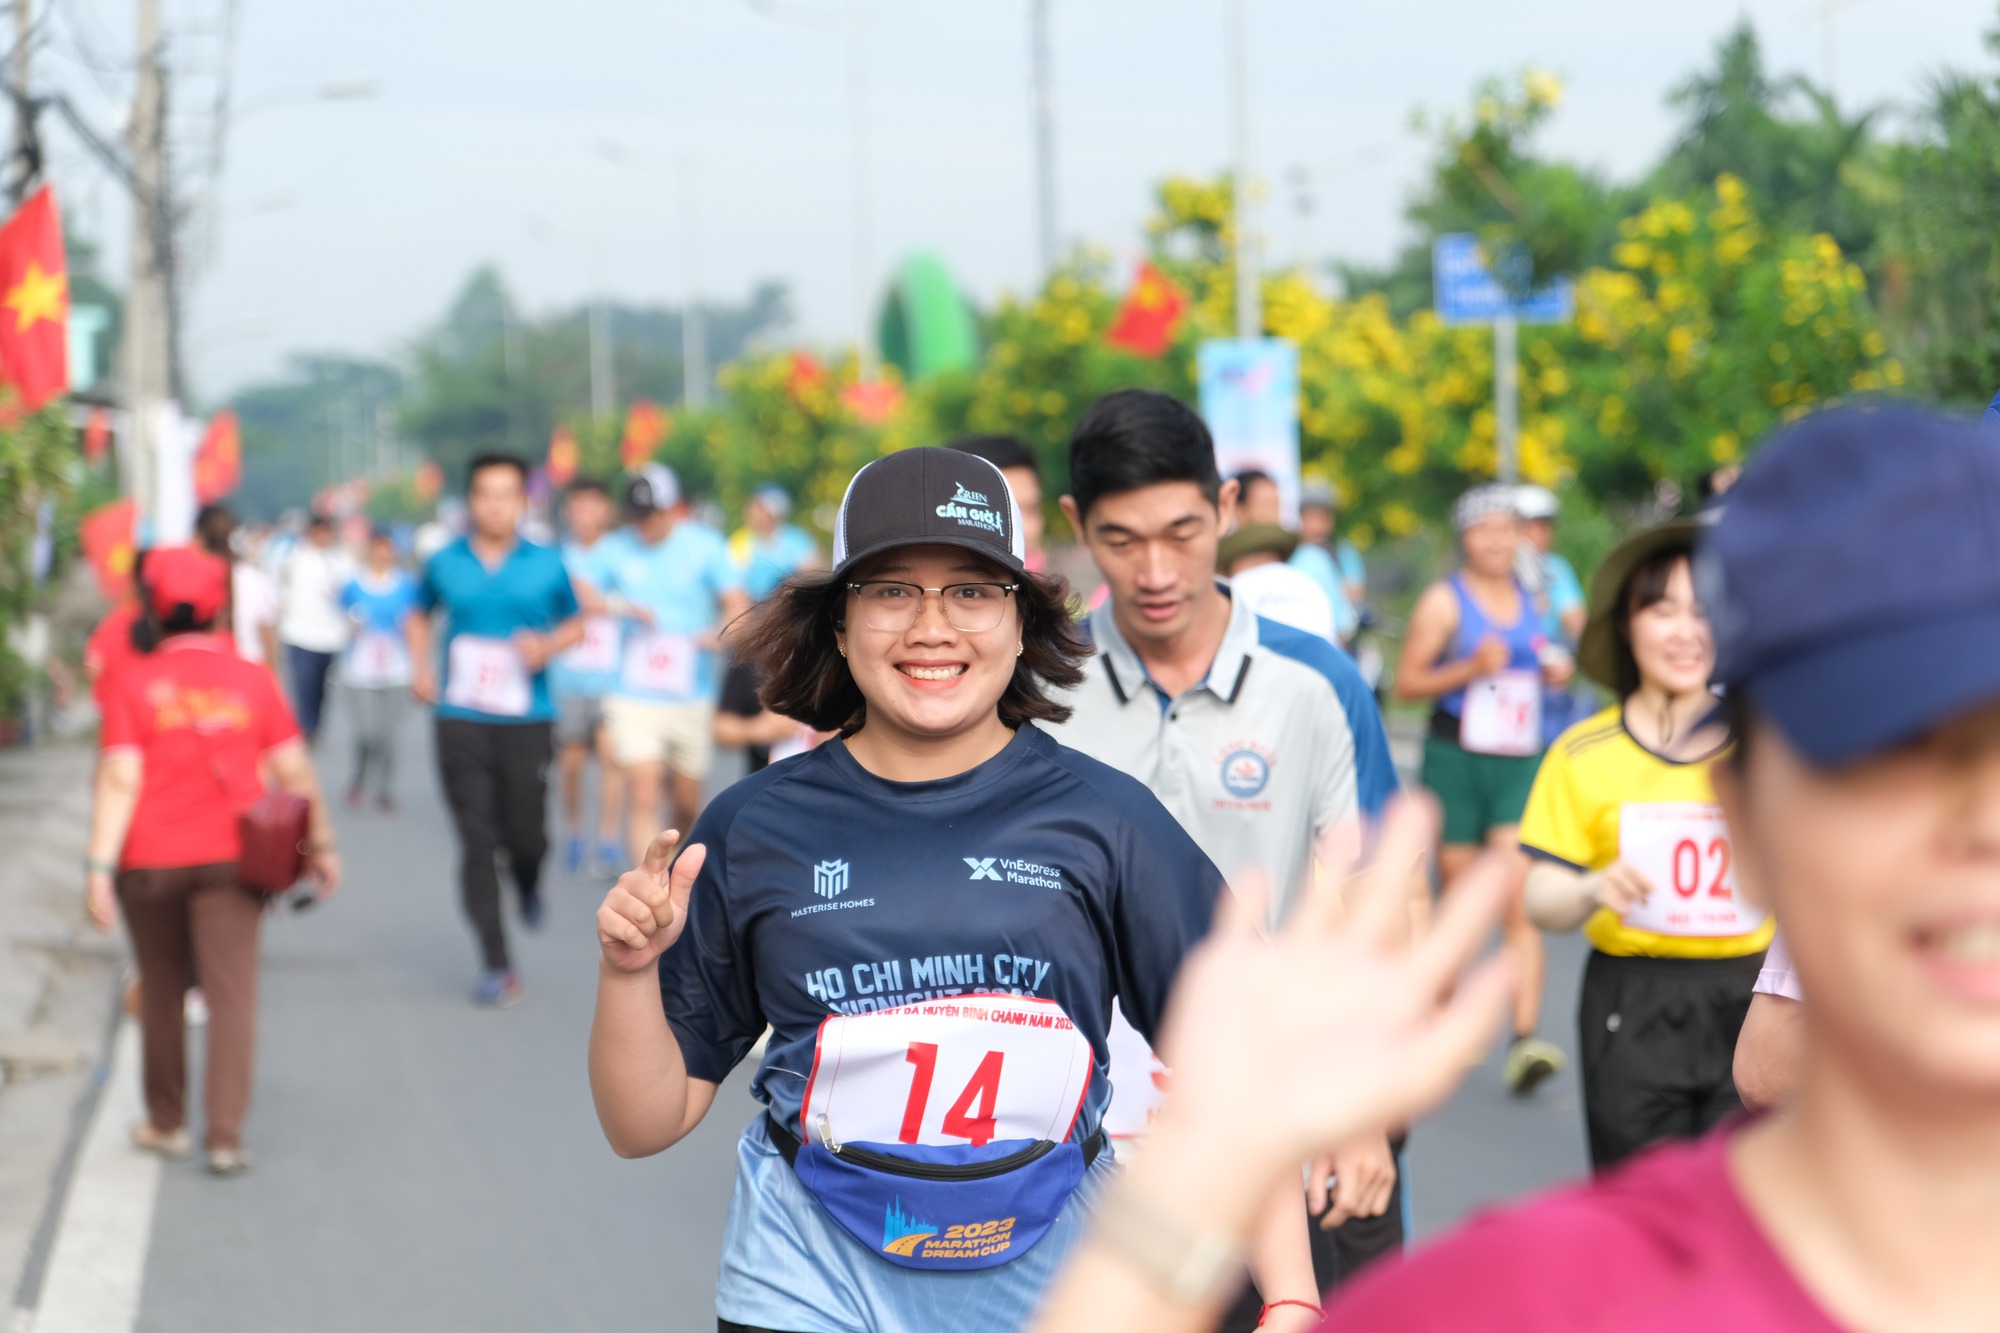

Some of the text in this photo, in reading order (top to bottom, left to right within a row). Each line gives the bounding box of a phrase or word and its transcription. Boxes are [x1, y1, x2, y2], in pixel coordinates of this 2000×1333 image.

[956, 486, 988, 503] GREEN
[936, 502, 993, 525] CẦN GIỜ
[957, 518, 995, 533] MARATHON
[1000, 858, 1060, 877] VnExpress
[1672, 837, 1733, 902] 02
[1007, 871, 1061, 890] Marathon
[791, 898, 875, 918] MASTERISE HOMES
[805, 954, 1051, 1002] HO CHI MINH CITY
[991, 1008, 1027, 1026] CHÁNH
[898, 1041, 1004, 1147] 14
[944, 1217, 1016, 1239] 2023
[921, 1241, 1011, 1258] DREAM CUP
[924, 1231, 1011, 1249] MARATHON
